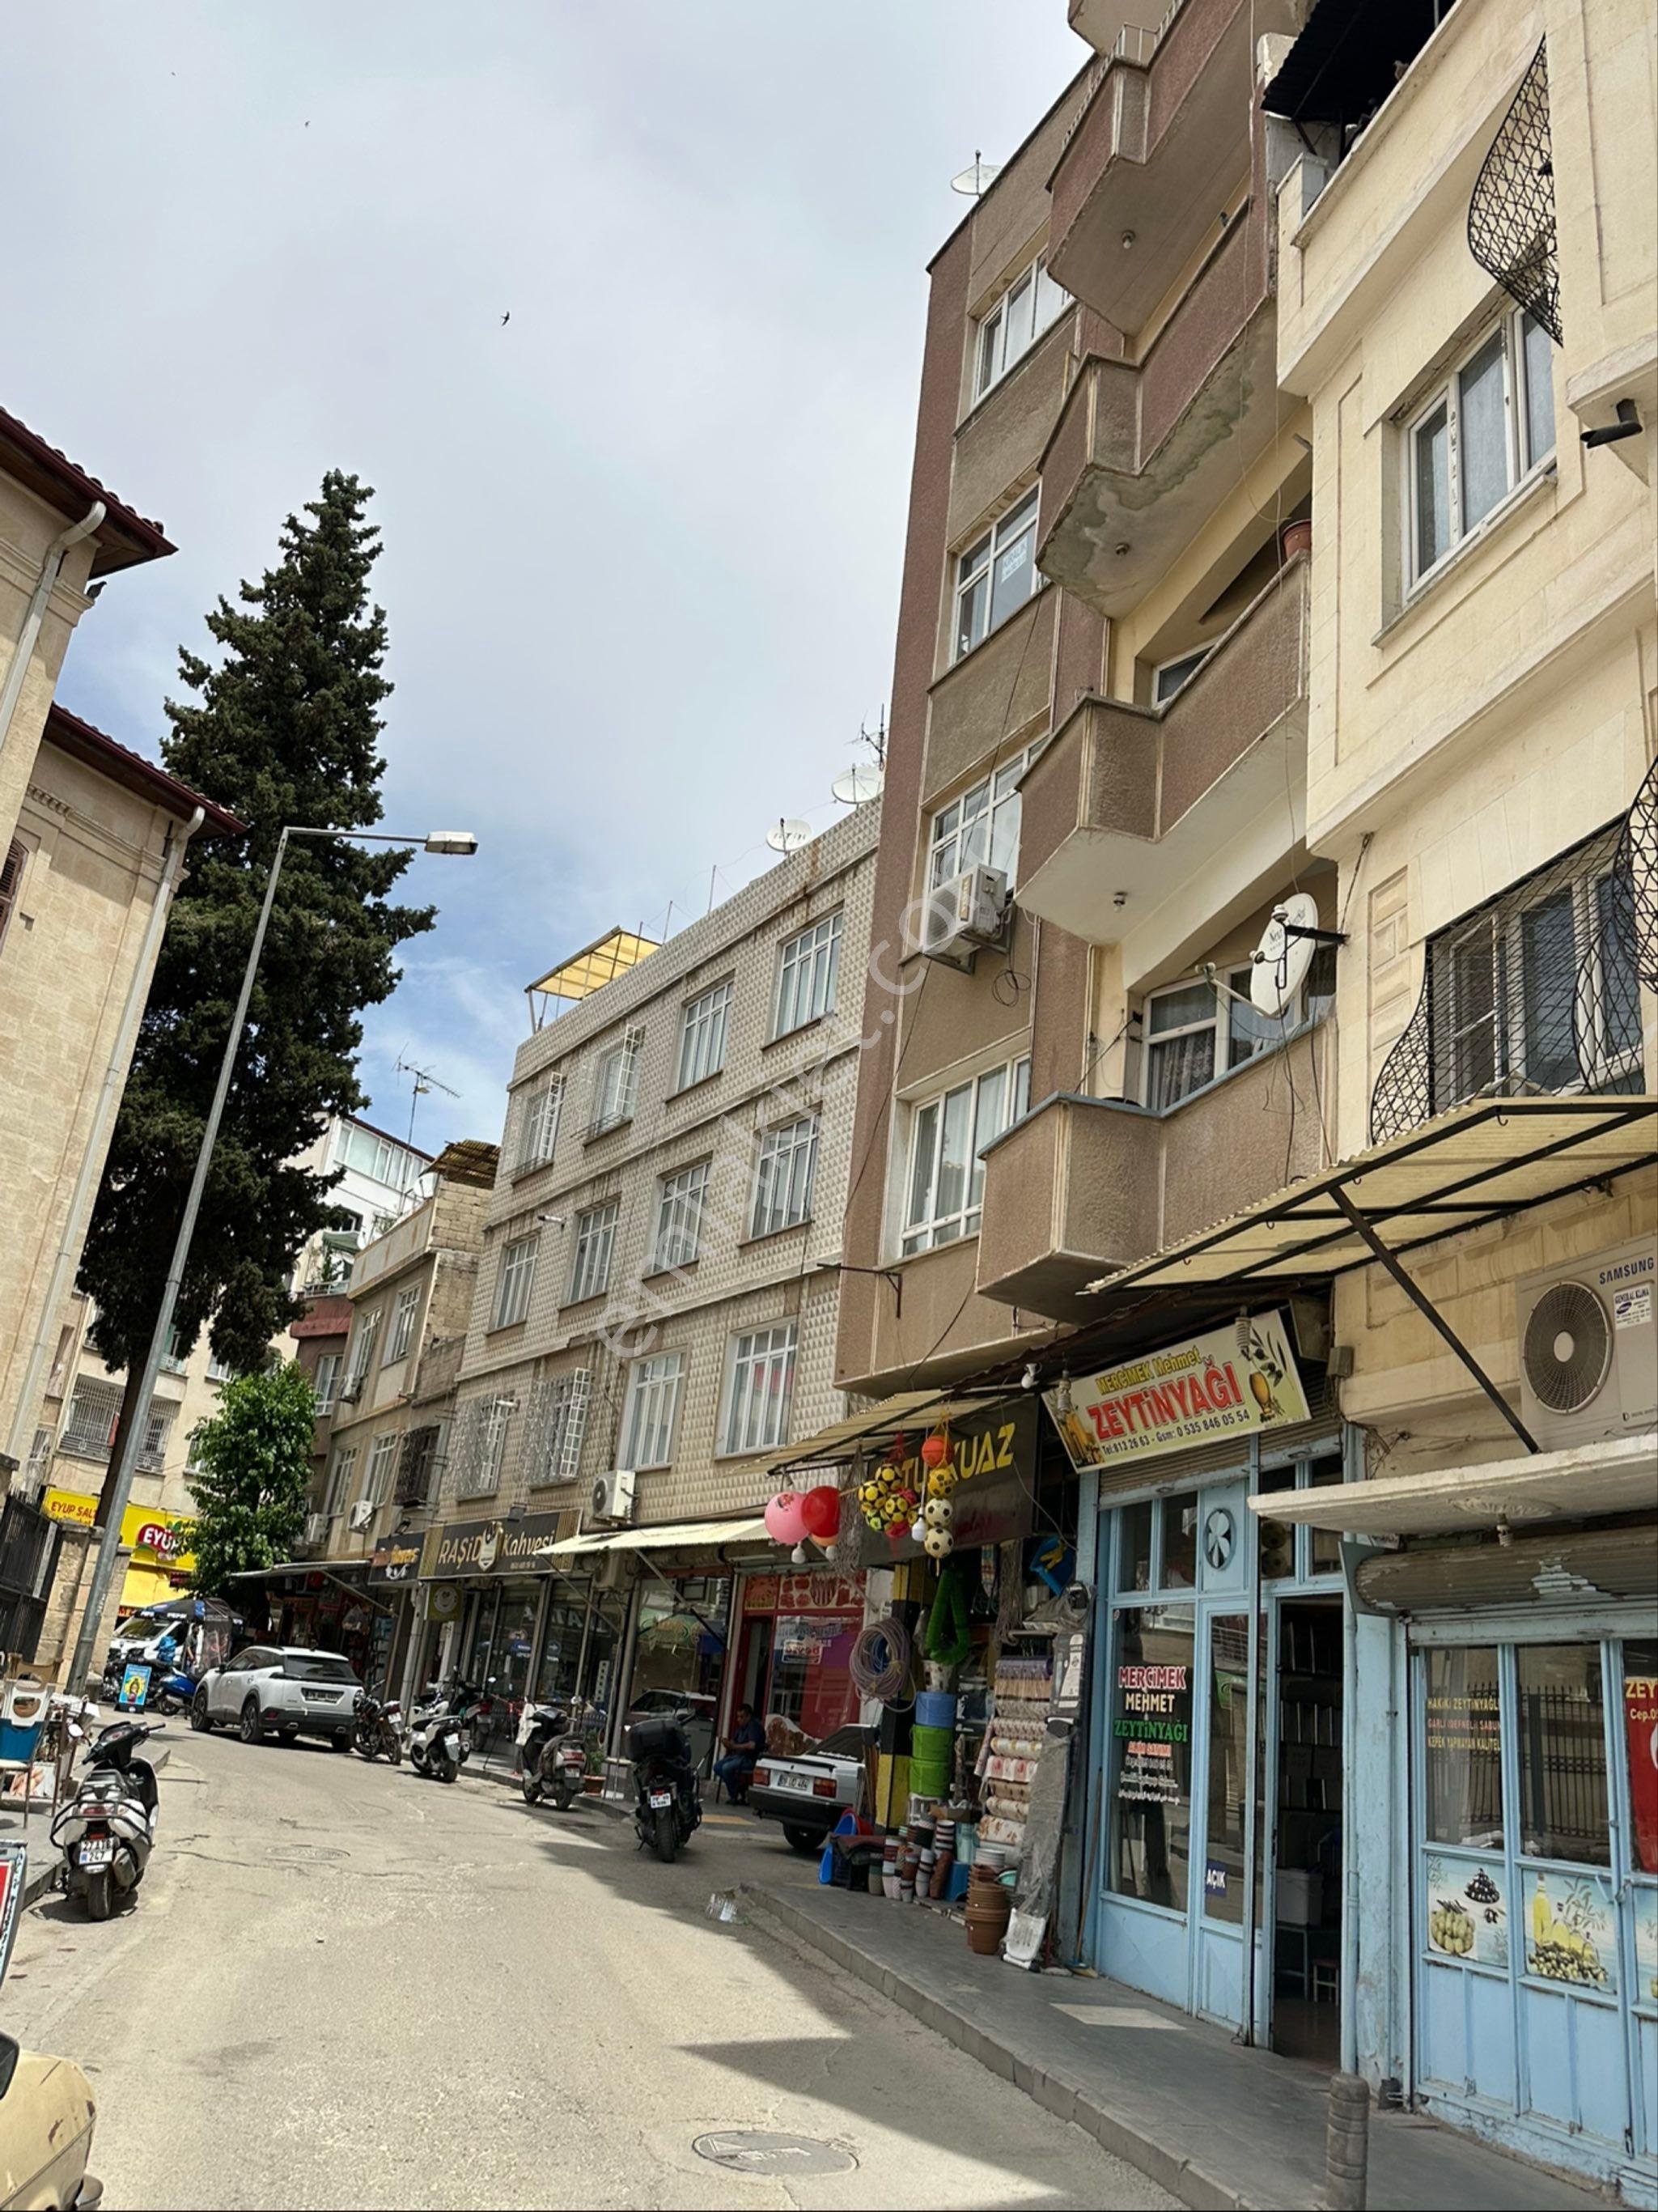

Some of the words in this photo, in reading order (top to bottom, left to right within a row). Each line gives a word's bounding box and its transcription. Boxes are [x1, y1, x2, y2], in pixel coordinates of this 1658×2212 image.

[1599, 1257, 1654, 1284] SAMSUNG
[1151, 1345, 1202, 1377] Mehmet
[1177, 1426, 1184, 1437] 0
[1184, 1422, 1202, 1436] 535
[1202, 1416, 1221, 1430] 846
[1222, 1414, 1235, 1426] 05
[1236, 1409, 1250, 1422] 54
[901, 1422, 1016, 1492] TUUAZ
[1625, 1677, 1658, 1698] ZEY
[1126, 1692, 1176, 1713] MEHMET
[1206, 1869, 1226, 1889] AÇIK
